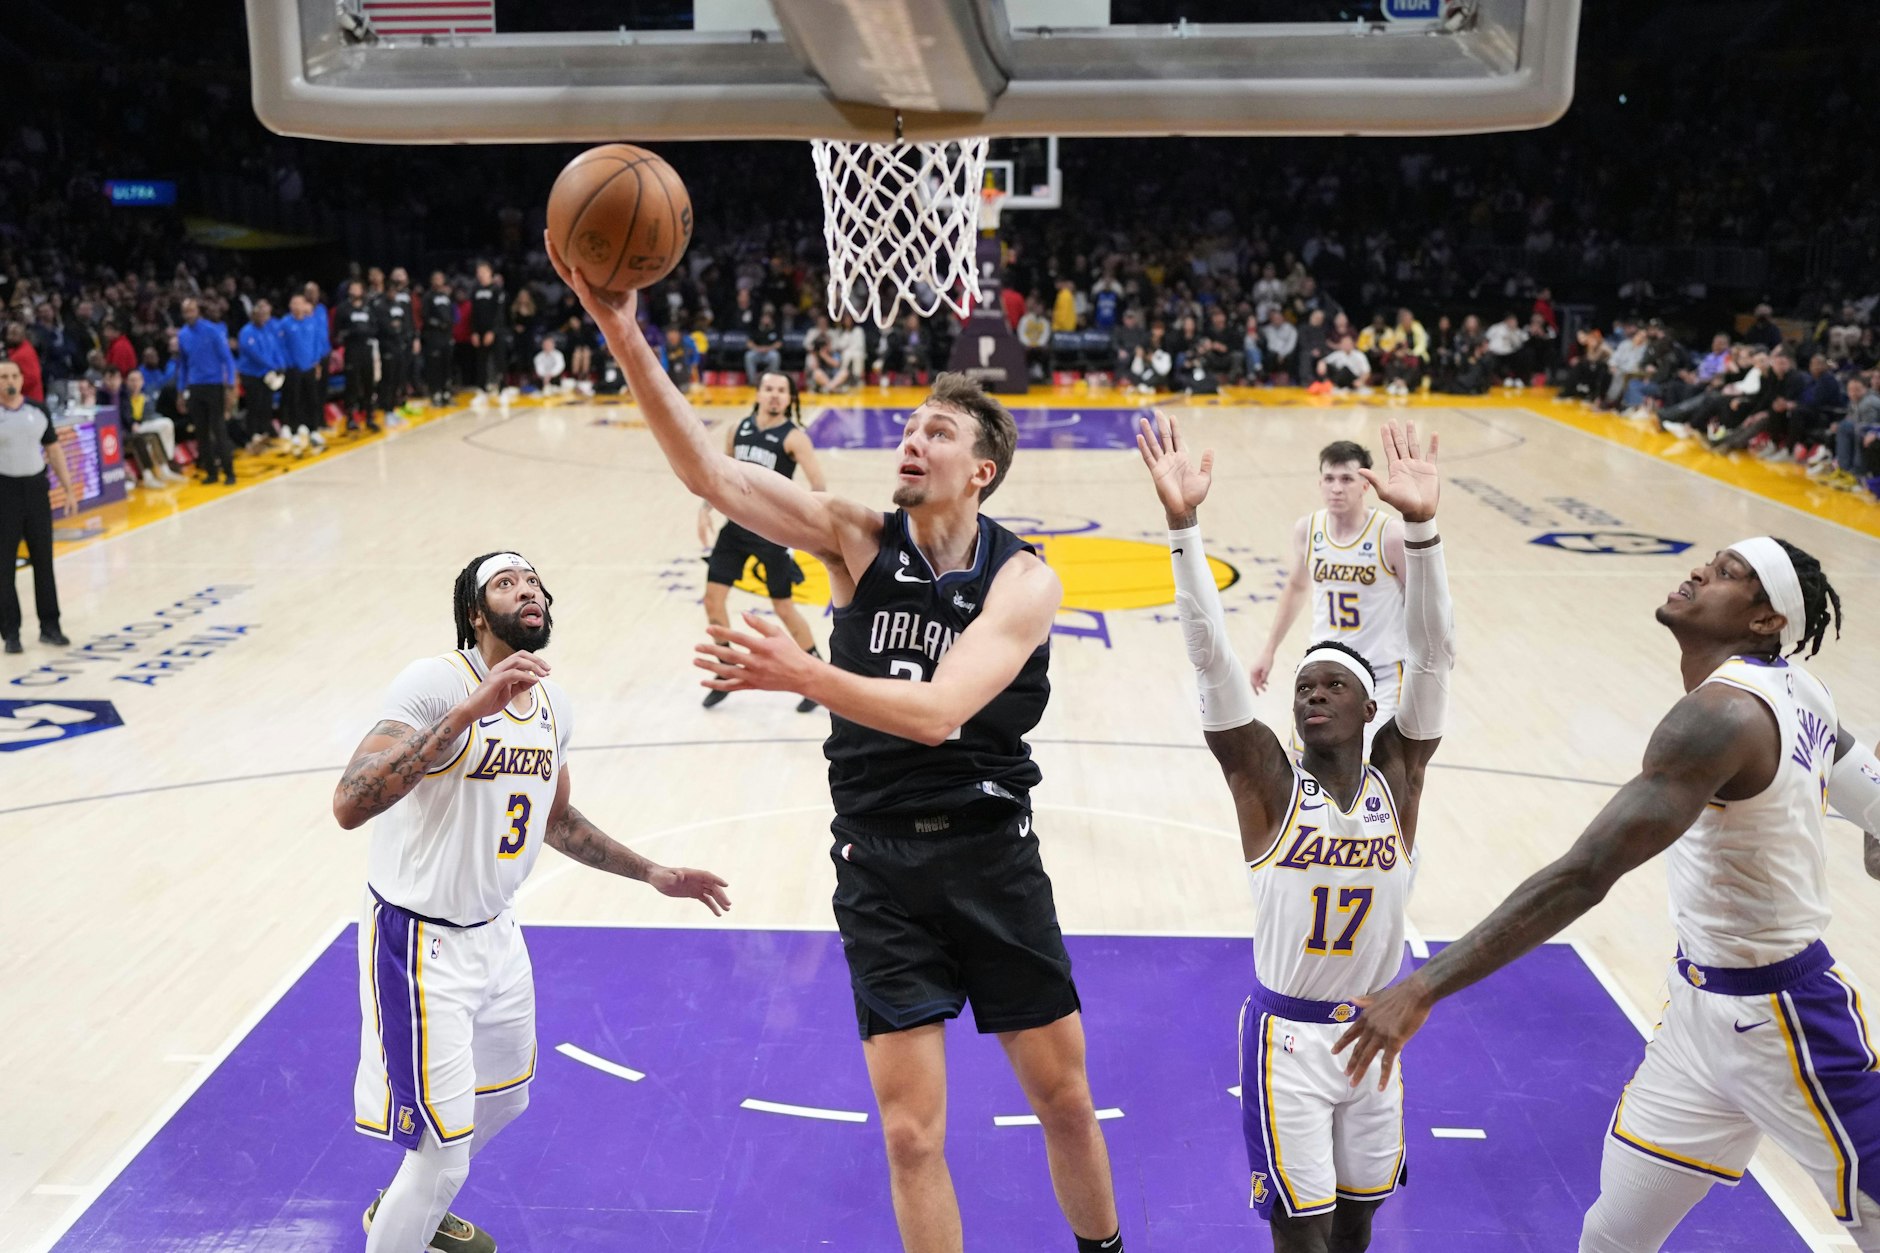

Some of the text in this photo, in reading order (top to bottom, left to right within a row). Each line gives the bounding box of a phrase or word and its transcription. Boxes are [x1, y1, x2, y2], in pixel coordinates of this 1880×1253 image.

[1313, 557, 1378, 586] LAKERS
[1327, 590, 1361, 631] 15
[110, 624, 262, 686] ARENA
[869, 610, 961, 665] ORLAN
[464, 737, 553, 782] LAKERS
[1303, 781, 1315, 795] 6
[497, 792, 533, 860] 3
[914, 815, 950, 833] MAGIC
[1363, 812, 1391, 824] bibigo
[1274, 824, 1398, 873] LAKERS
[1305, 884, 1375, 957] 17
